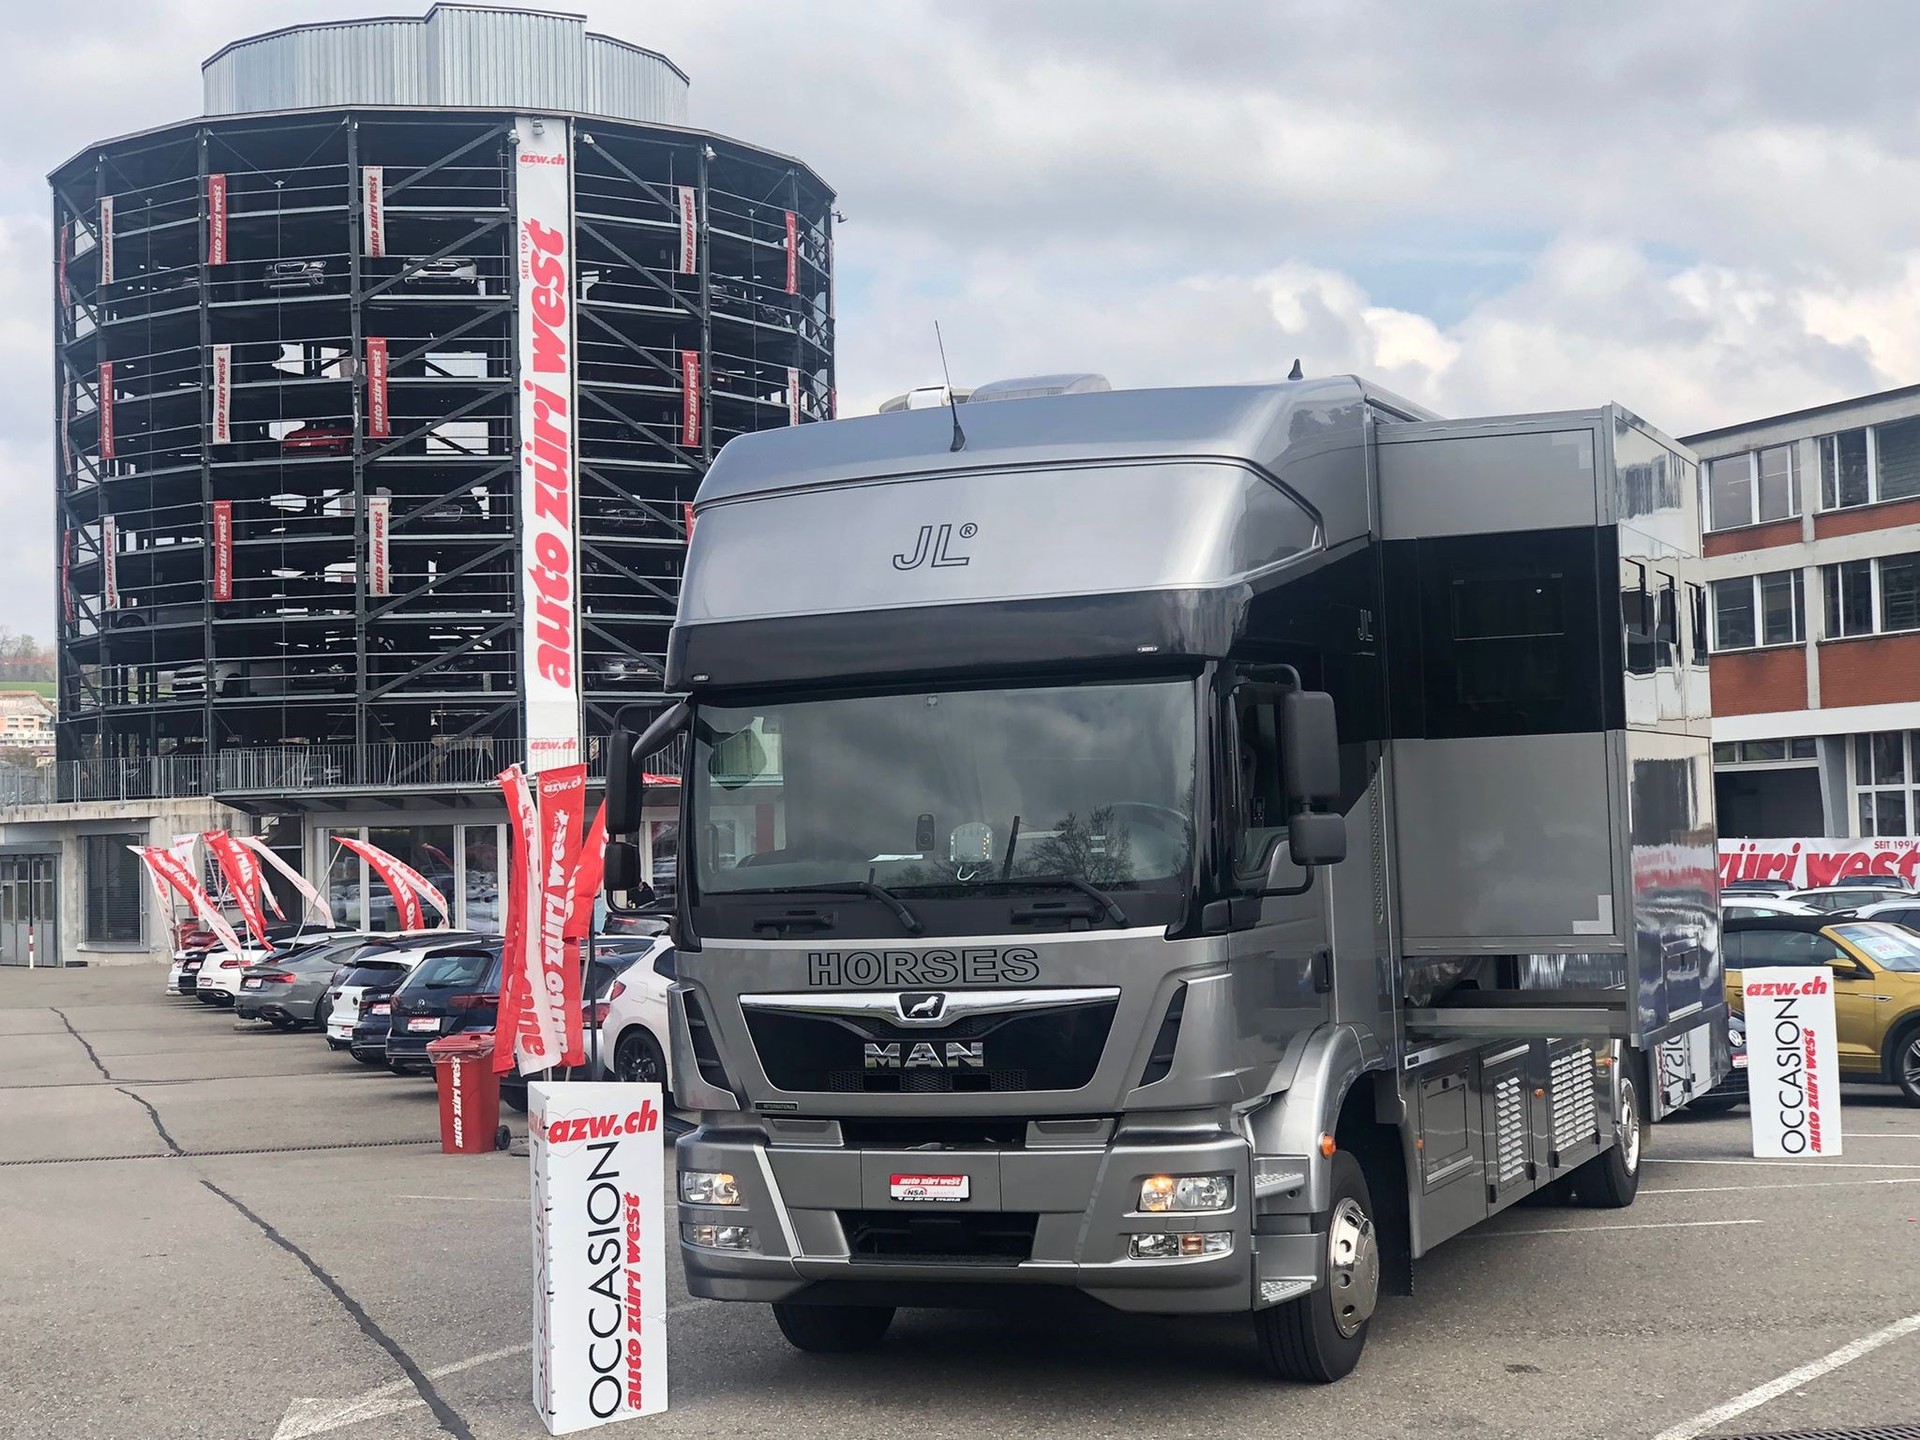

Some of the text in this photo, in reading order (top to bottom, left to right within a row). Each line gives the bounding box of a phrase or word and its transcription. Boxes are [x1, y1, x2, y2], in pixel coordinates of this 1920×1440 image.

[520, 153, 565, 165] azw.ch
[368, 176, 377, 202] west
[372, 349, 382, 377] west
[687, 362, 696, 388] west
[372, 377, 382, 404] züri
[374, 404, 383, 433] auto
[522, 218, 571, 688] auto züri west
[218, 514, 227, 542] west
[374, 511, 383, 538] west
[374, 539, 384, 565] züri
[375, 566, 383, 594] auto
[530, 738, 577, 750] azw.ch
[548, 809, 570, 887] west
[1874, 840, 1914, 849] SEIT 1991
[1806, 841, 1920, 888] west
[808, 947, 1040, 986] HORSES
[1746, 976, 1828, 997] azw.ch
[864, 1042, 984, 1068] MAN
[1774, 998, 1806, 1154] OCCASION
[1802, 1027, 1822, 1153] auto züri west
[451, 1056, 463, 1148] auto züri west
[548, 1100, 658, 1144] azw.ch
[899, 1177, 961, 1186] auto züri west
[587, 1141, 622, 1418] OCCASION
[623, 1192, 642, 1411] auto züri west
